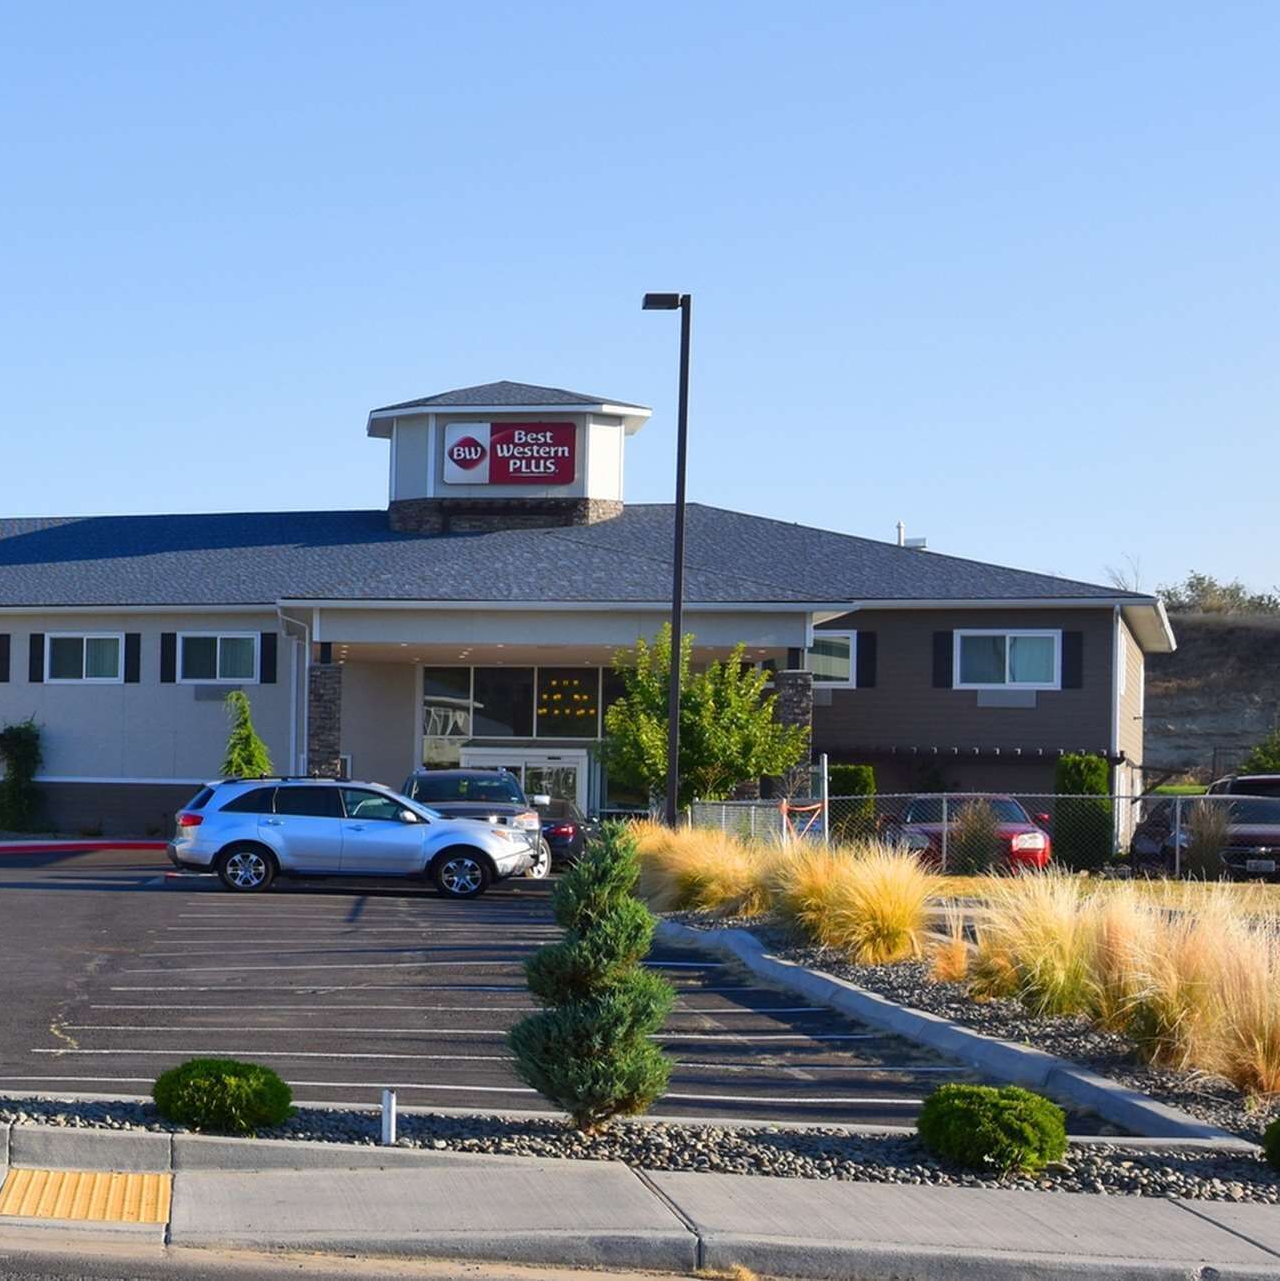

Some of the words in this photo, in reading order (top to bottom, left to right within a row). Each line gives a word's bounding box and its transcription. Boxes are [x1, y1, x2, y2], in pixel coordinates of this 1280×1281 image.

[514, 430, 554, 444] Best
[453, 446, 481, 460] BW
[496, 444, 570, 457] Western
